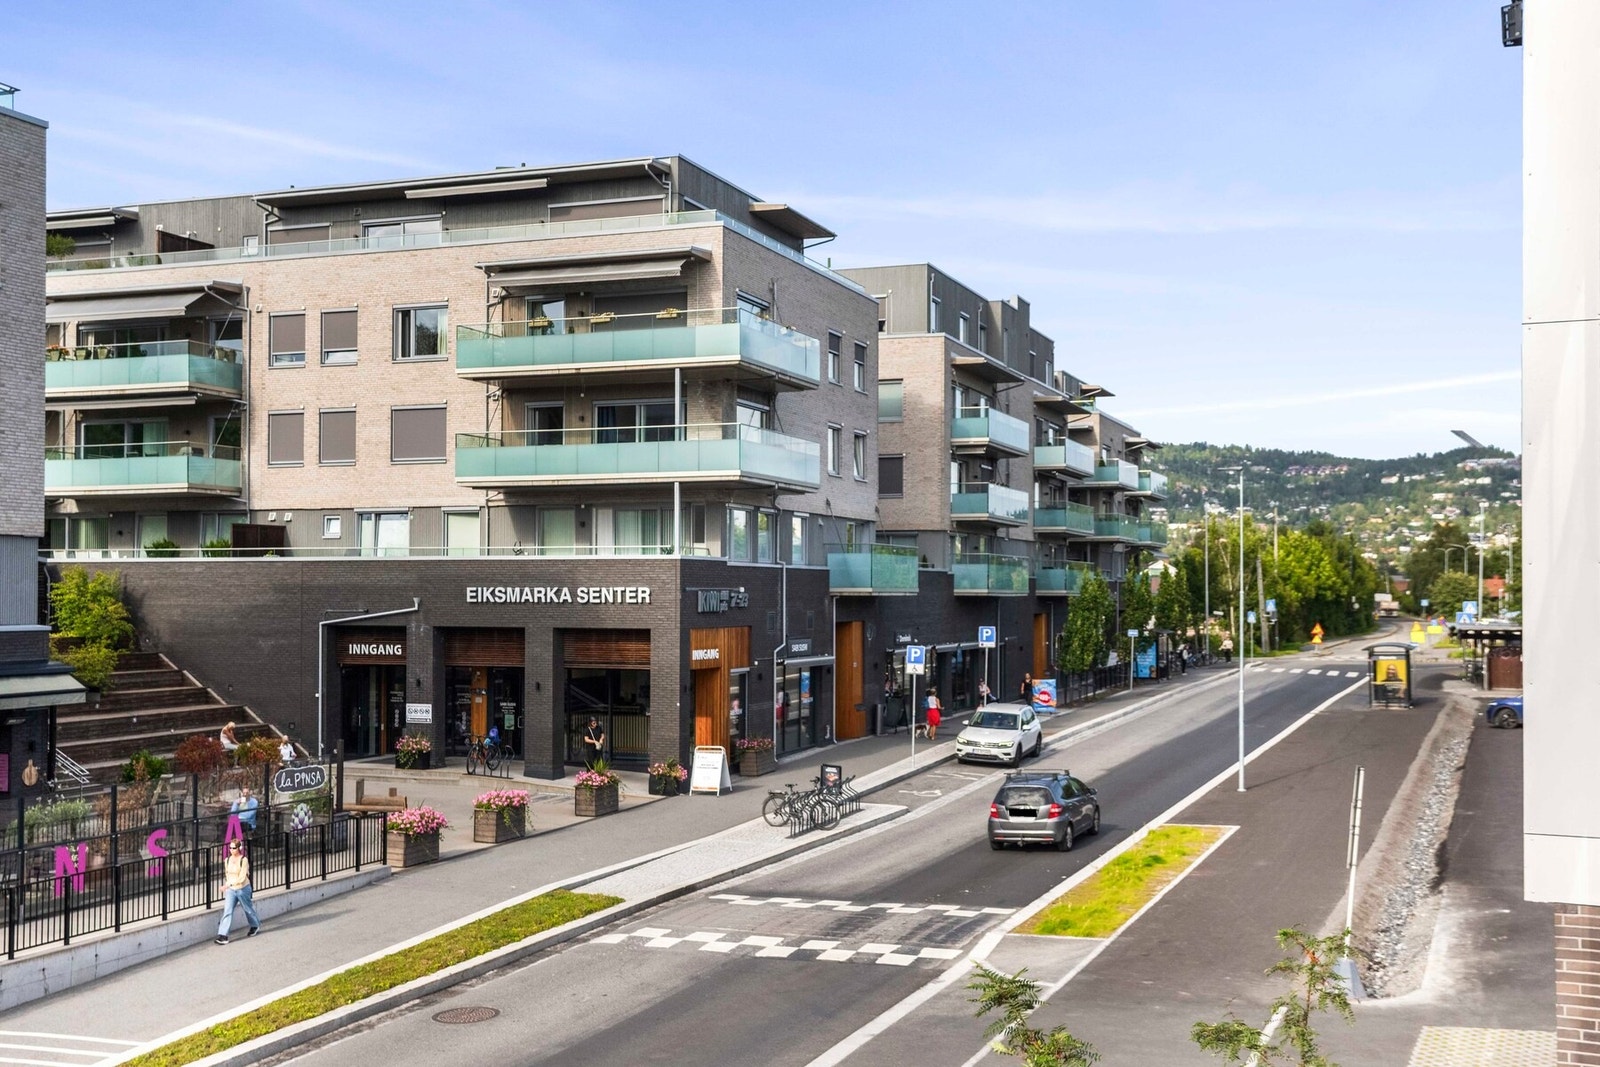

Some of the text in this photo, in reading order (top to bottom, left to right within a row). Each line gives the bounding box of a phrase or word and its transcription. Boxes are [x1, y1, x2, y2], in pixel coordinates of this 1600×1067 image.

[466, 587, 651, 604] EIKSMARKA SENTER
[697, 590, 720, 613] KIWI
[983, 628, 992, 641] P
[349, 644, 402, 655] INNGANG
[692, 649, 719, 661] INNGANG
[910, 648, 921, 662] P
[279, 771, 322, 788] la PINSA
